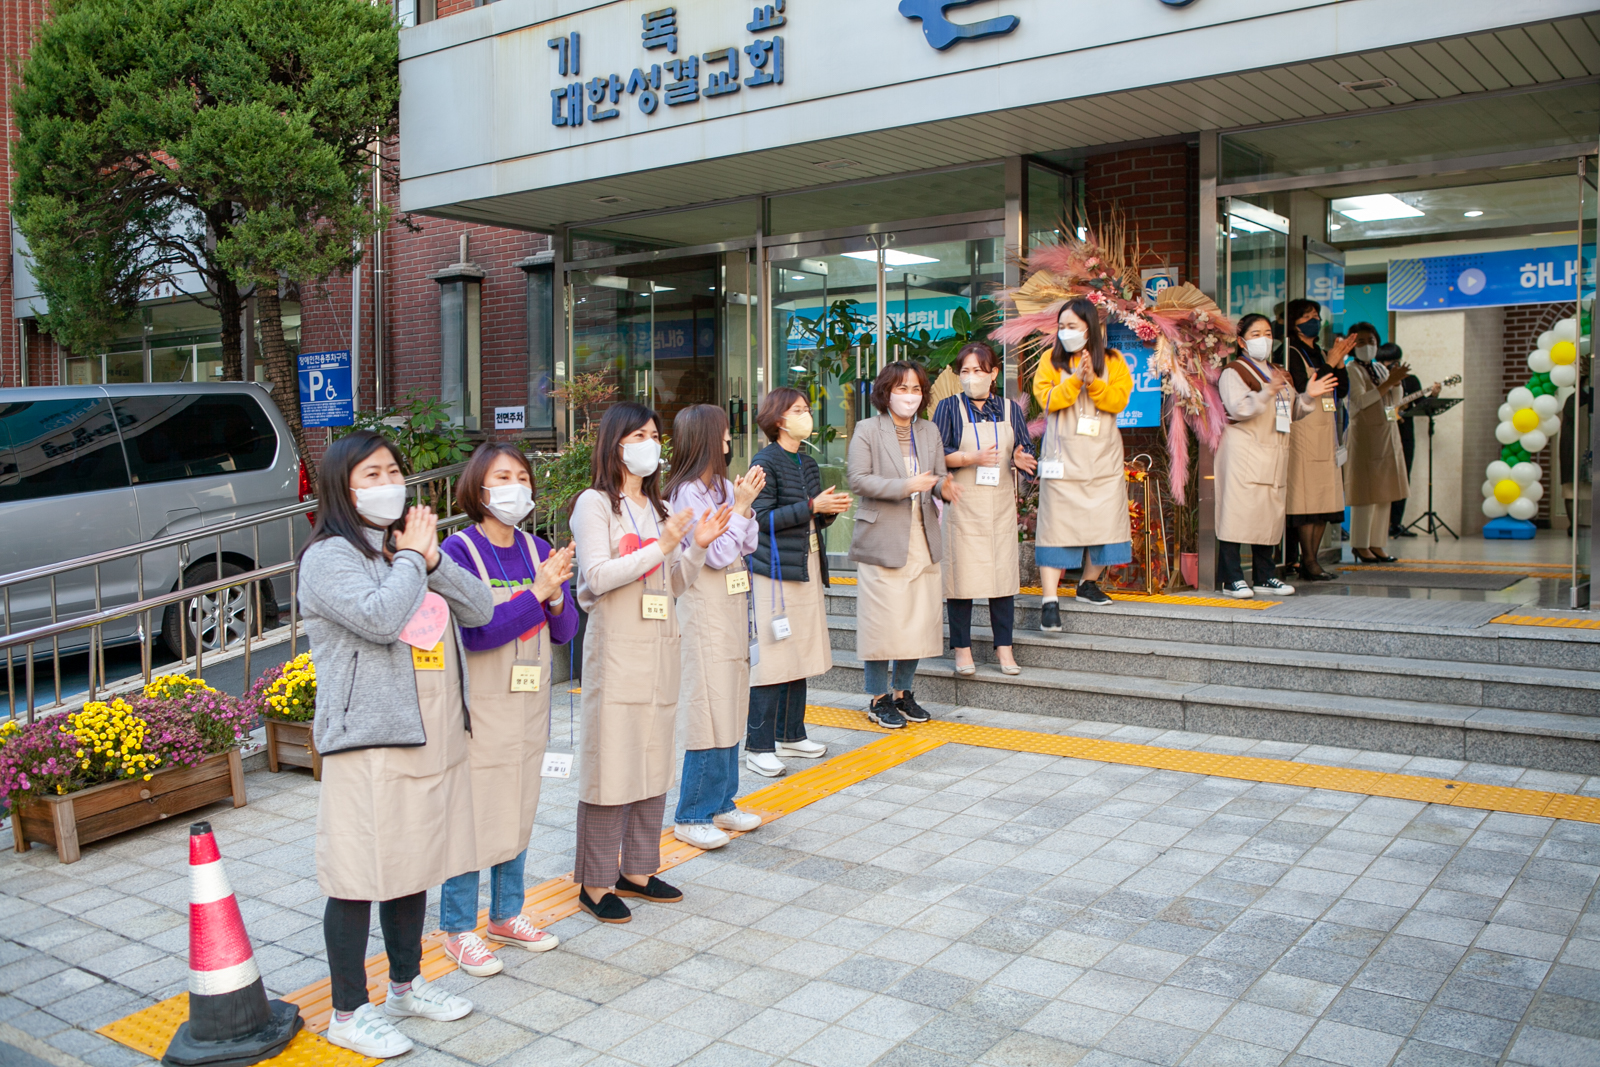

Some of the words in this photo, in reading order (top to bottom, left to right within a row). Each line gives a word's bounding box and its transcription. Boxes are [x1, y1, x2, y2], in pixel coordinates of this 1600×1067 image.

[550, 35, 785, 127] 대한성결교회
[309, 371, 324, 402] P
[496, 411, 524, 424] 전면주차
